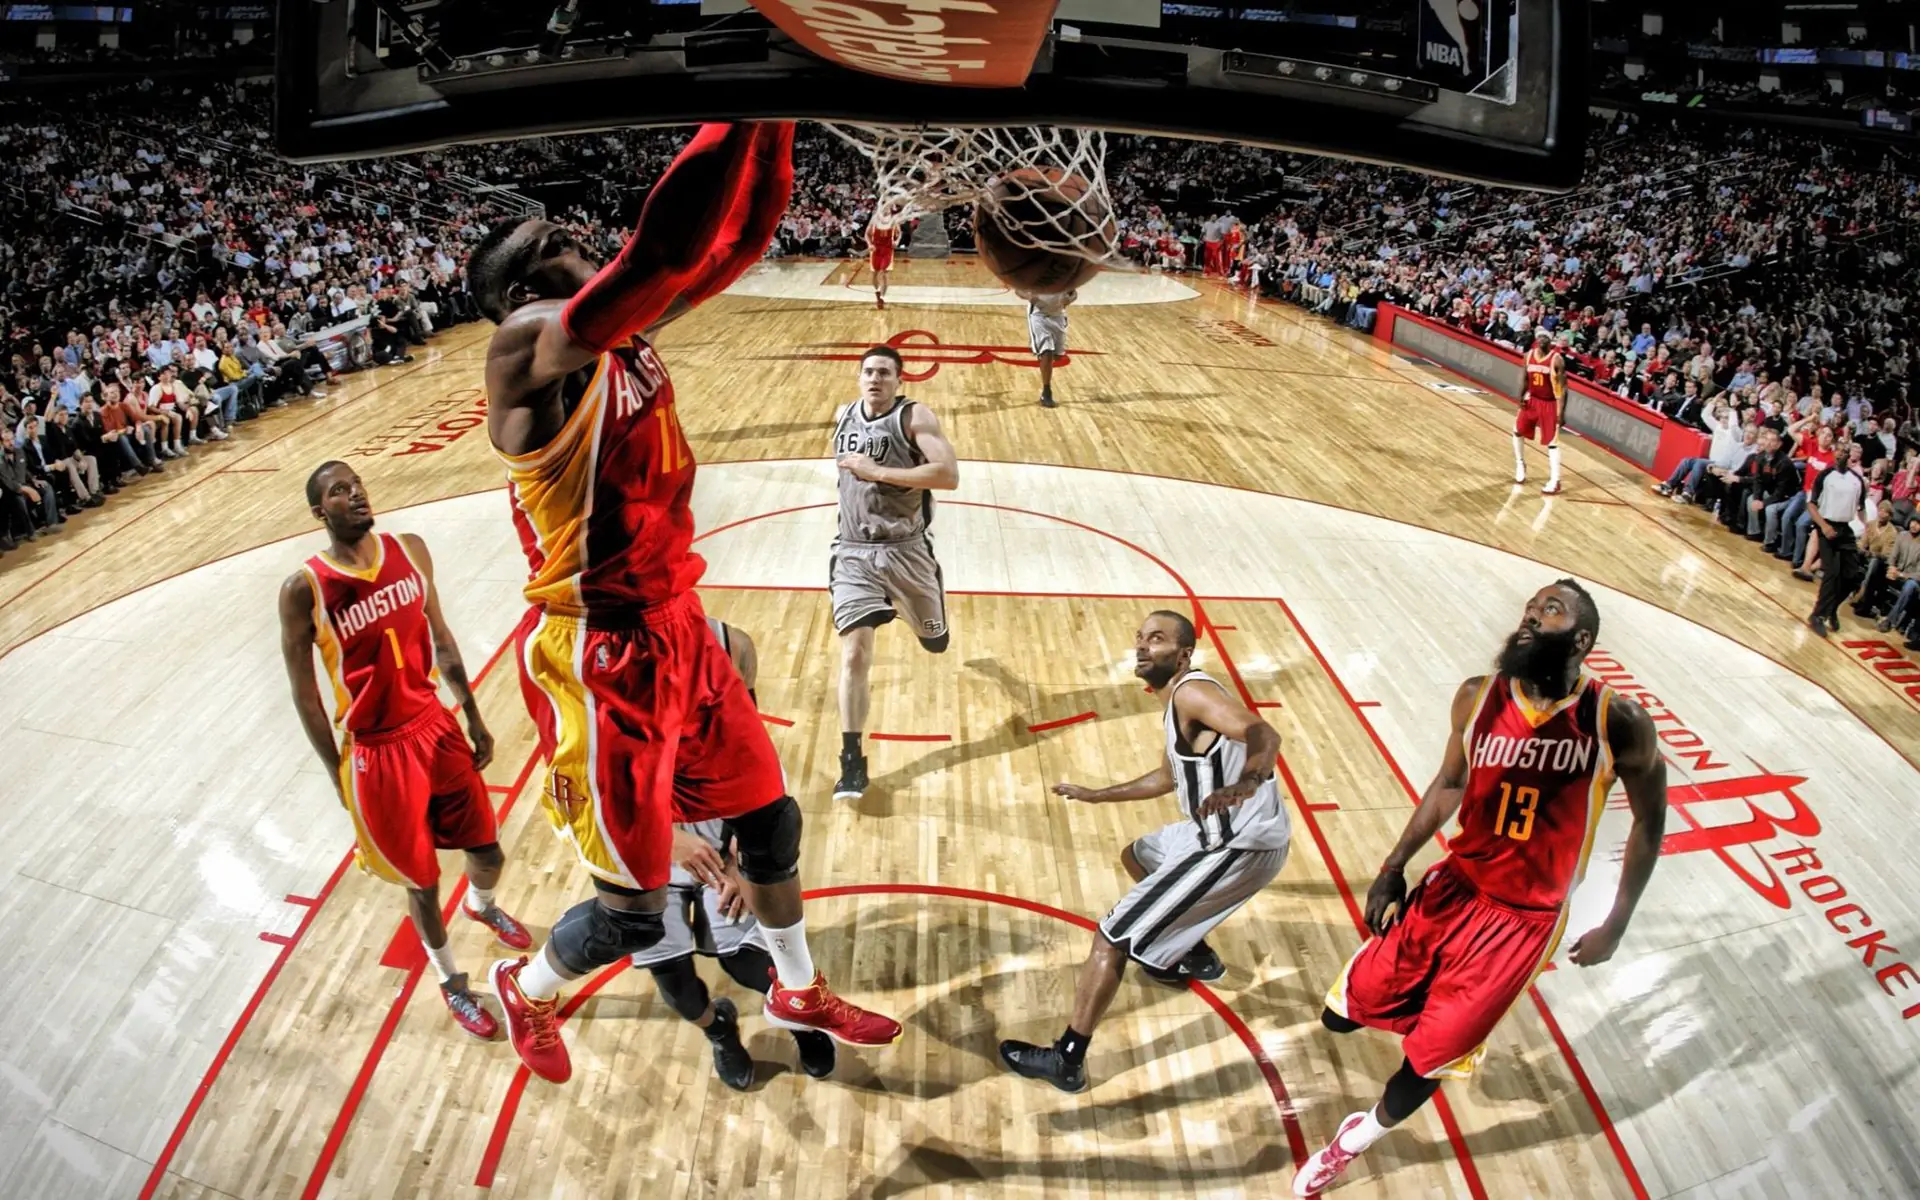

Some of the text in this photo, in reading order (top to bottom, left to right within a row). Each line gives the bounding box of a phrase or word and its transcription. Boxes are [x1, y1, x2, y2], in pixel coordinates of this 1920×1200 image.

[1426, 41, 1460, 68] NBA
[1532, 372, 1544, 387] 31
[342, 388, 483, 458] CENTER
[839, 433, 859, 453] 16
[334, 571, 421, 641] HOUSTON
[384, 627, 405, 670] 1
[1472, 732, 1593, 774] HOUSTON
[1494, 781, 1540, 842] 13
